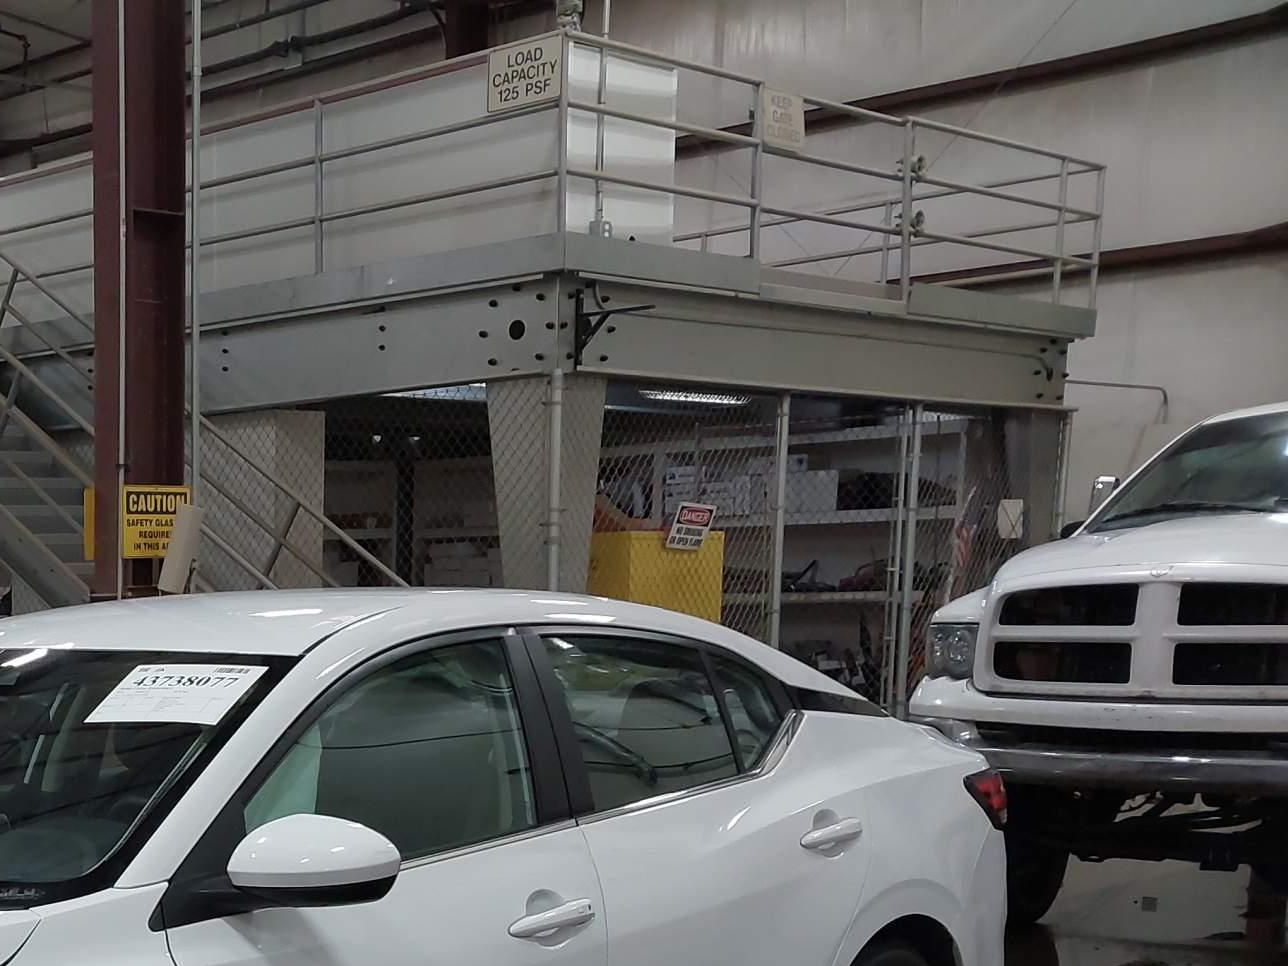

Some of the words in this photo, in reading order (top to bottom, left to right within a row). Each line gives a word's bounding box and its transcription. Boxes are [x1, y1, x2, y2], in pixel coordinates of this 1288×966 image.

[507, 47, 543, 68] LOAD
[493, 59, 558, 88] CAPACITY
[498, 86, 519, 103] 125
[525, 78, 551, 97] PSF
[129, 494, 185, 512] CAUTION
[127, 519, 153, 527] SAFETY
[155, 519, 174, 527] GLAS
[680, 510, 710, 523] DANGER
[134, 542, 141, 550] IN
[143, 542, 159, 550] THIS
[133, 676, 240, 688] 43738077
